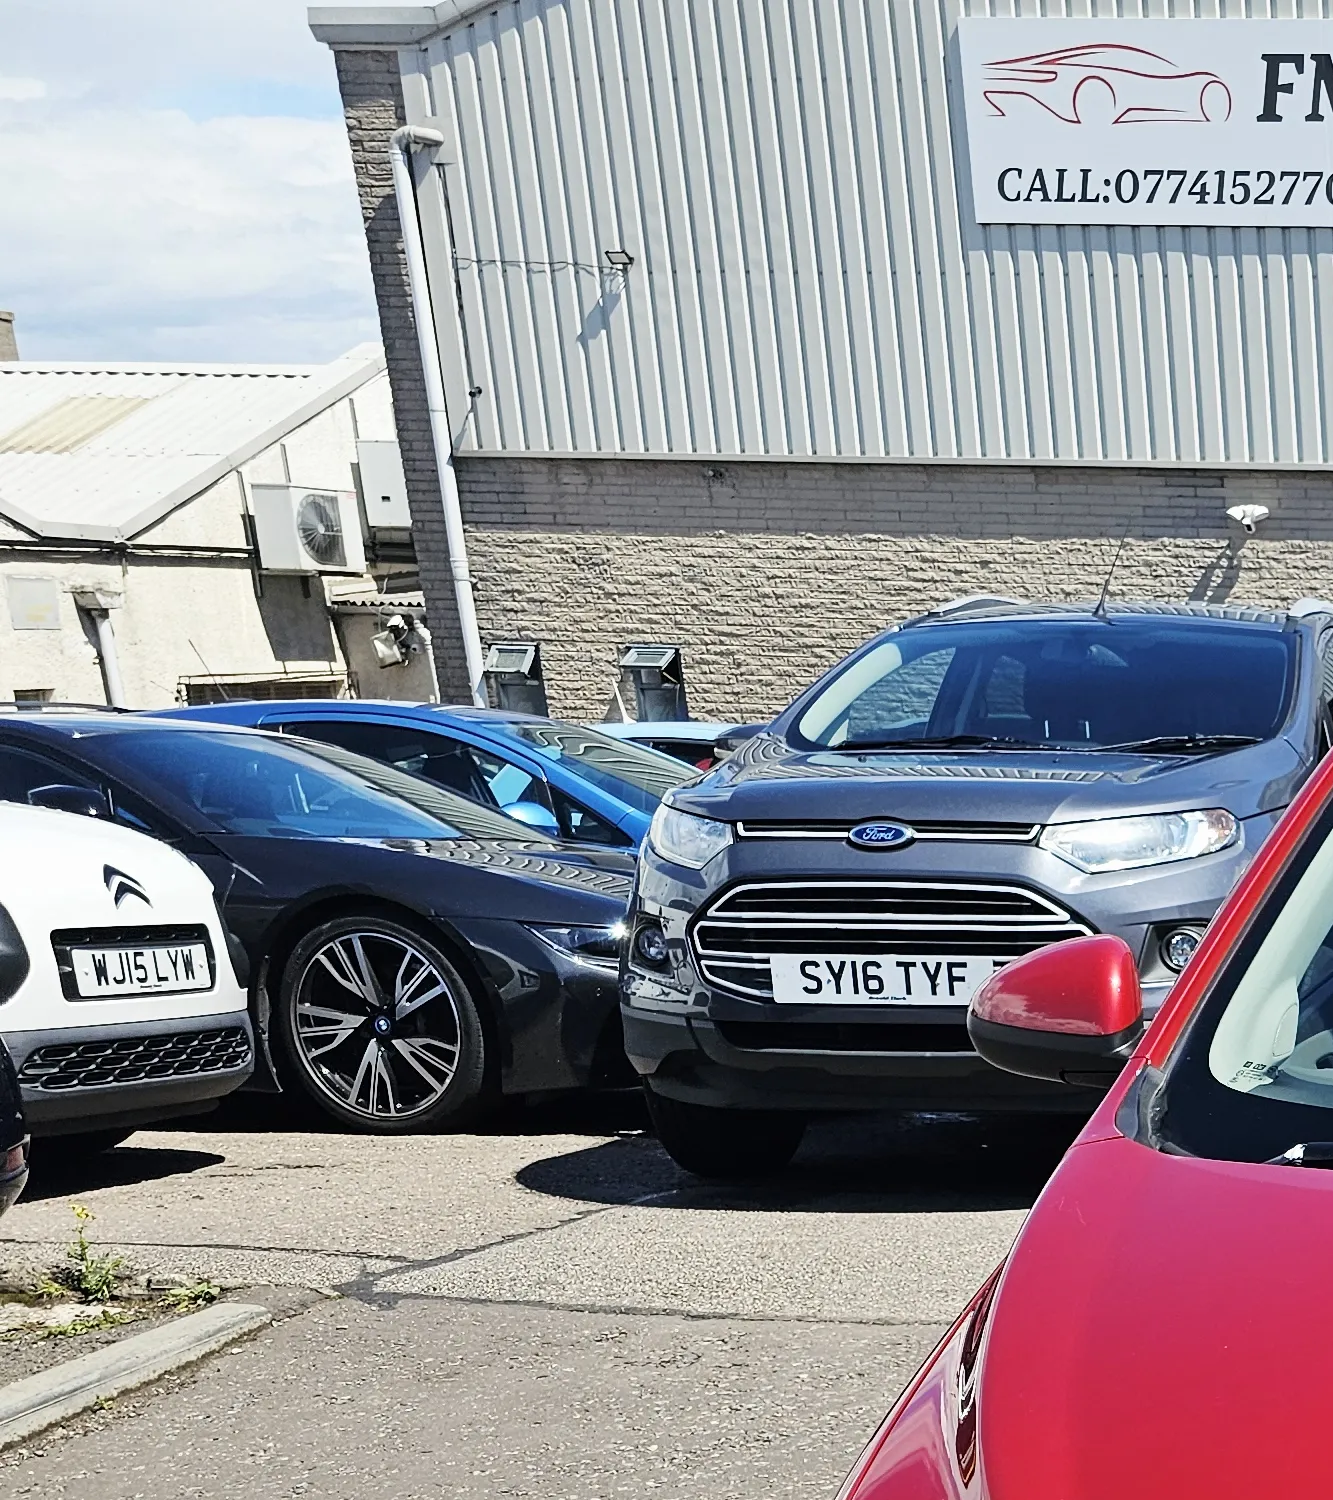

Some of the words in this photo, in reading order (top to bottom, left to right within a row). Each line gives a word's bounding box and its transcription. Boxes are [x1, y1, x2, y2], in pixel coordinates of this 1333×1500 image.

[863, 827, 896, 840] Ford
[92, 951, 148, 986] WJ15
[152, 948, 195, 982] LYW
[799, 960, 885, 995] SY16
[895, 961, 968, 996] TYF
